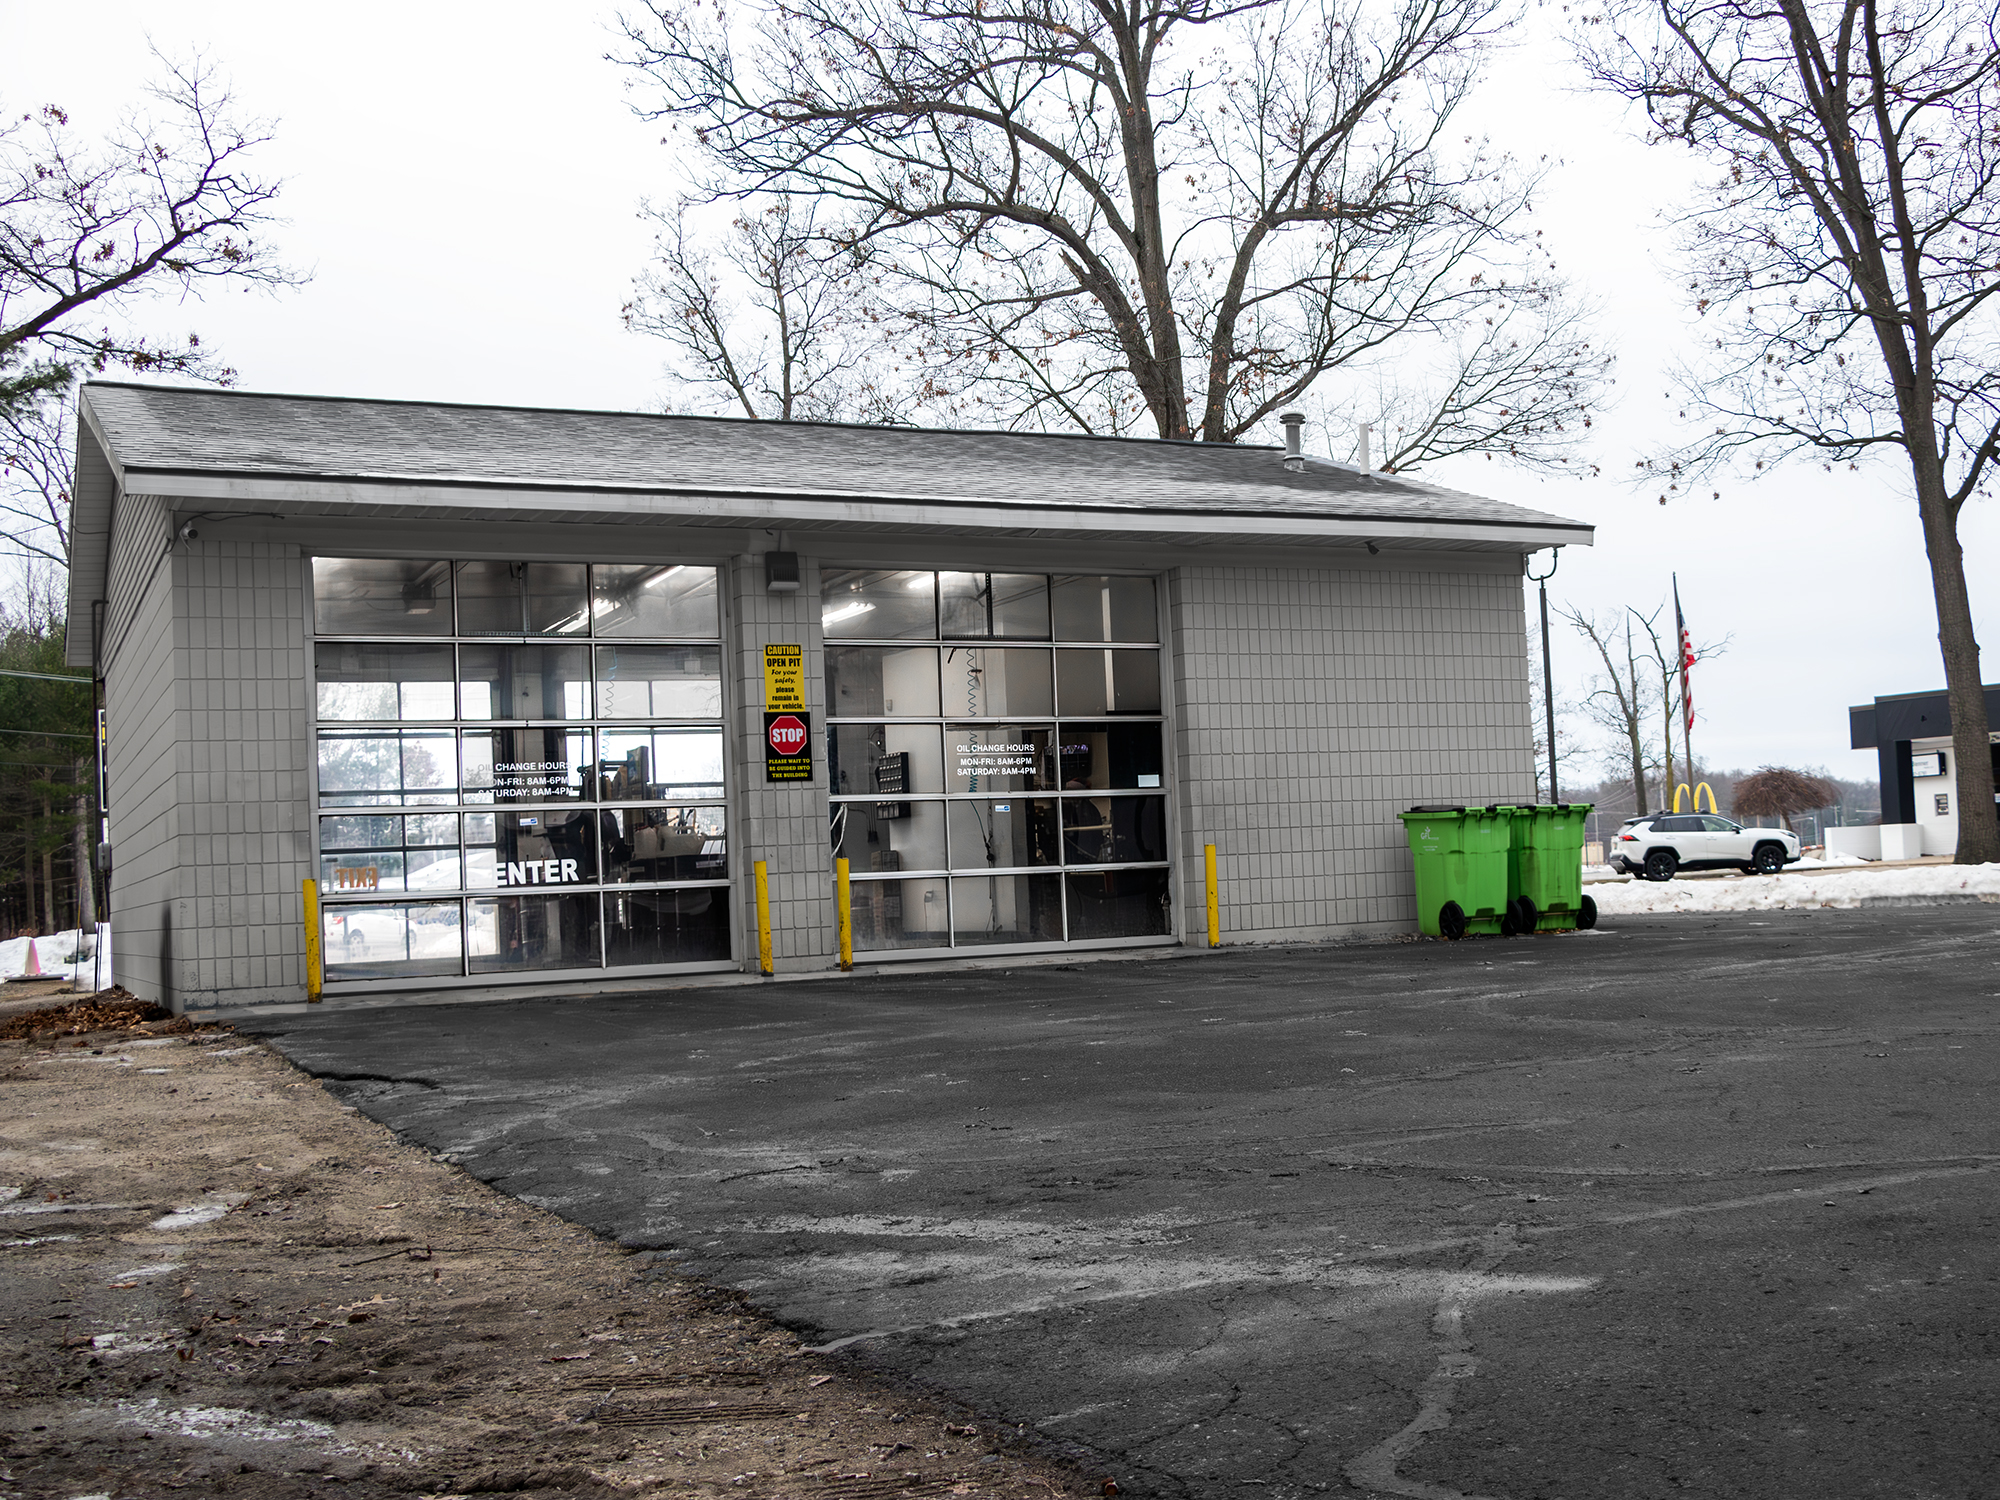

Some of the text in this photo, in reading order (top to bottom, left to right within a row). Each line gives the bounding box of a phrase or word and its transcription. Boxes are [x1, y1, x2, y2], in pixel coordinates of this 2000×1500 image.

[767, 645, 800, 655] CAUTION
[767, 658, 801, 667] OPEN PIT
[772, 727, 804, 743] STOP
[956, 743, 1035, 753] OIL CHANGE HOURS
[477, 761, 572, 772] OIL CHANGE HOURS
[960, 757, 1032, 766] MON-FRI: 8AM-6PM
[957, 766, 1037, 776] SATURDAY: 8AM-4PM
[526, 776, 569, 785] 8AM-6PM
[532, 786, 574, 796] 8AM-4PM
[491, 858, 579, 887] ENTER
